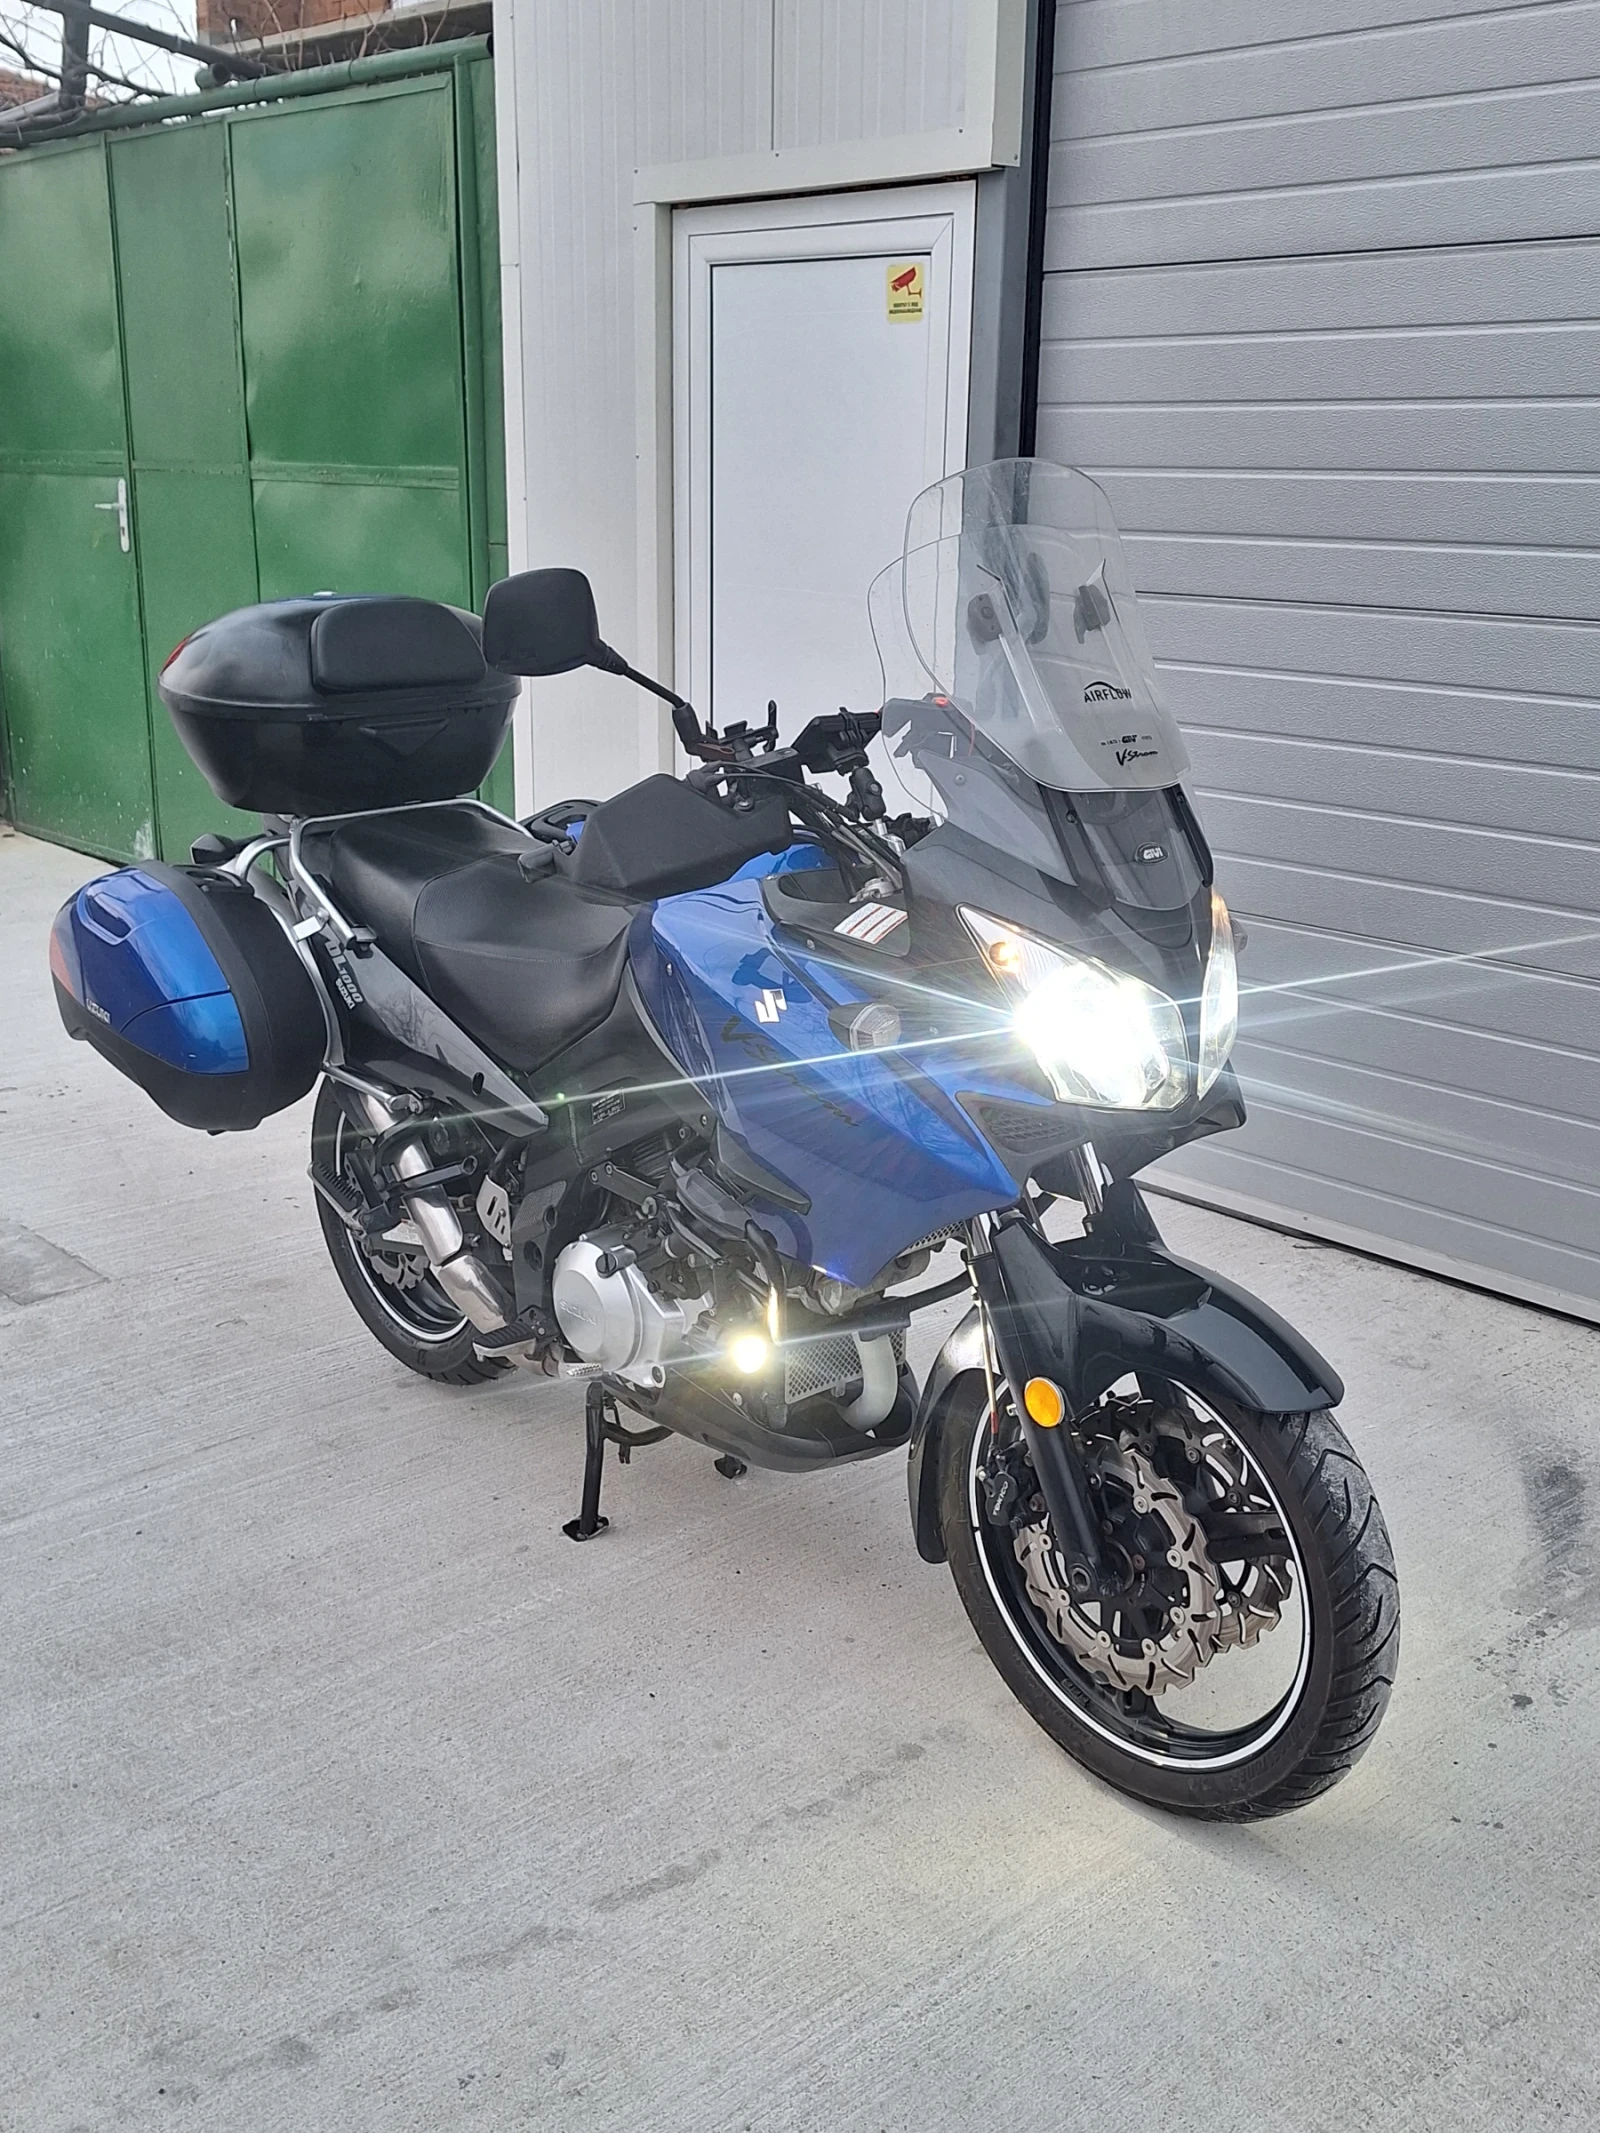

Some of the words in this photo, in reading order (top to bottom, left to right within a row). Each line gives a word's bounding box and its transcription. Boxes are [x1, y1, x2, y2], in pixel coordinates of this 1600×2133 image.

[1084, 687, 1132, 703] AIRFLOW
[1143, 847, 1164, 860] GIVI
[324, 940, 364, 1003] DL1000
[335, 978, 356, 1010] SUZUKI
[992, 1481, 1009, 1516] TOKICO
